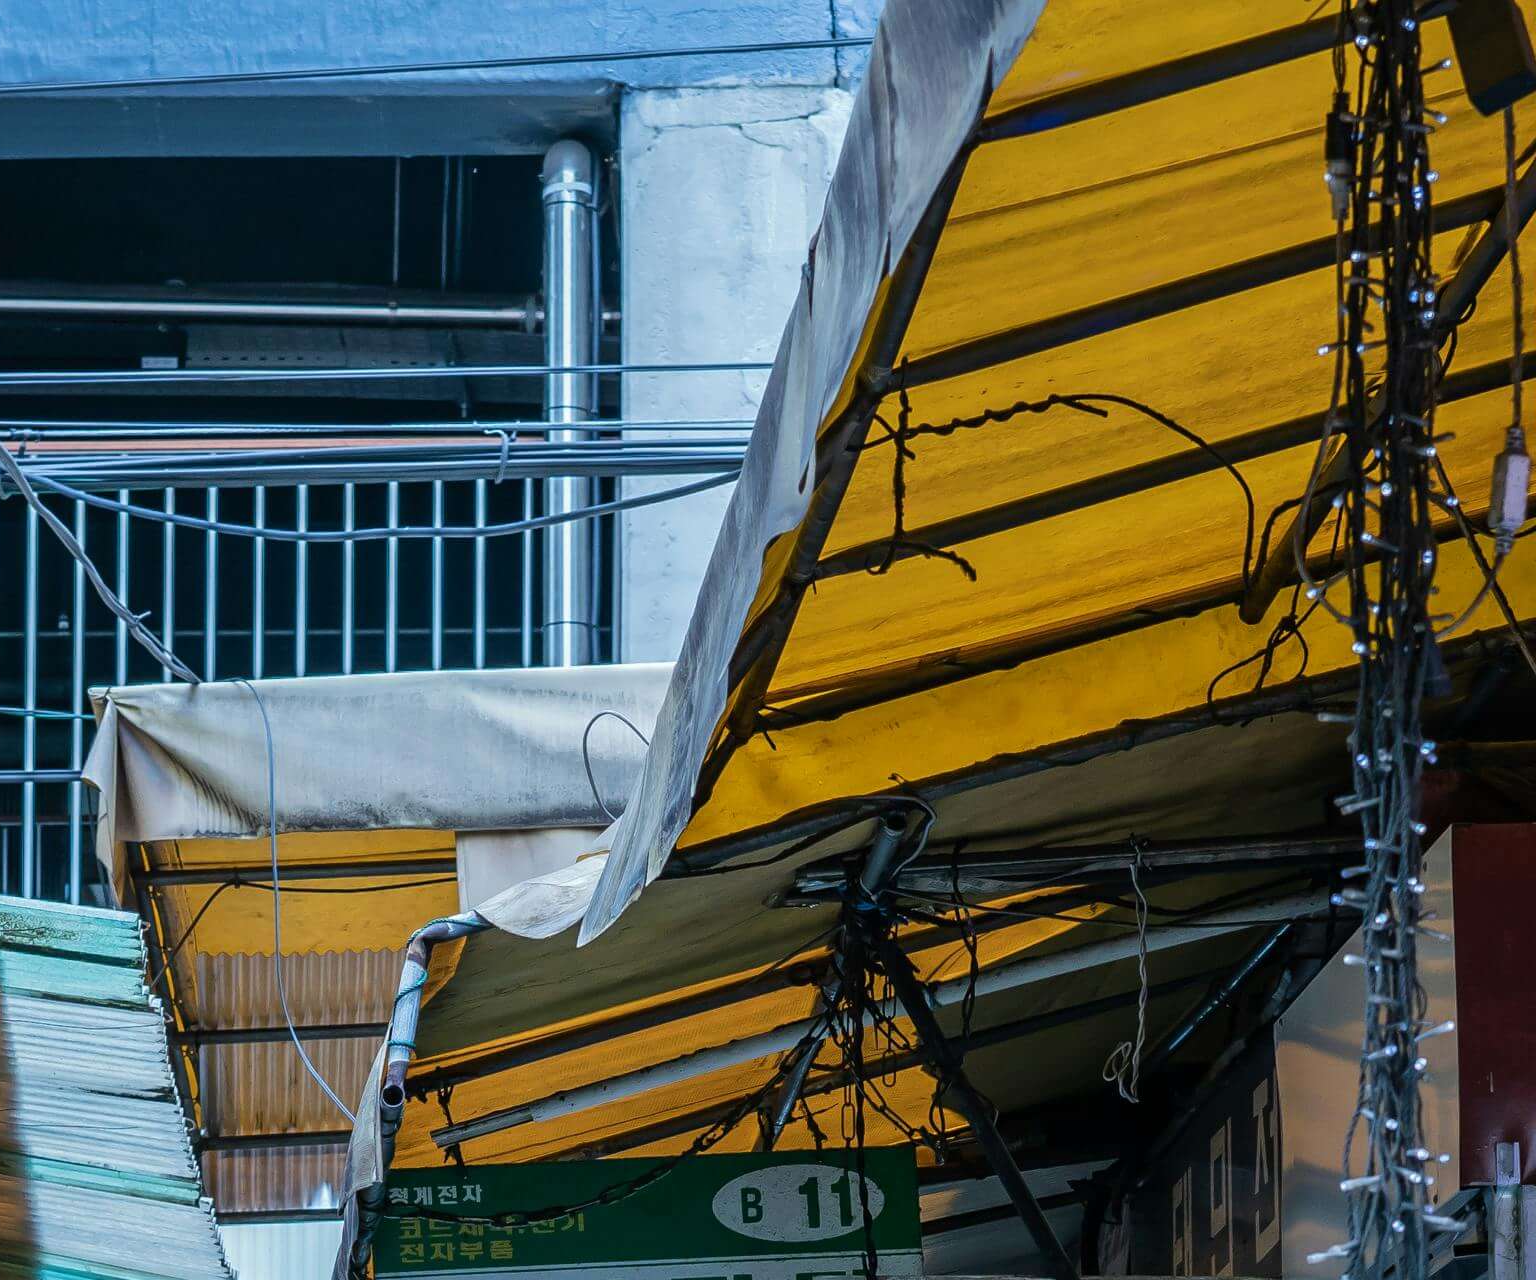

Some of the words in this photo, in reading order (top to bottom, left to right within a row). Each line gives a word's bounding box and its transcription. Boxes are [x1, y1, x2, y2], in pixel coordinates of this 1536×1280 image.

[388, 1184, 483, 1207] 청계전자
[741, 1186, 763, 1224] B
[798, 1176, 856, 1228] 11
[399, 1240, 514, 1265] 전자부품
